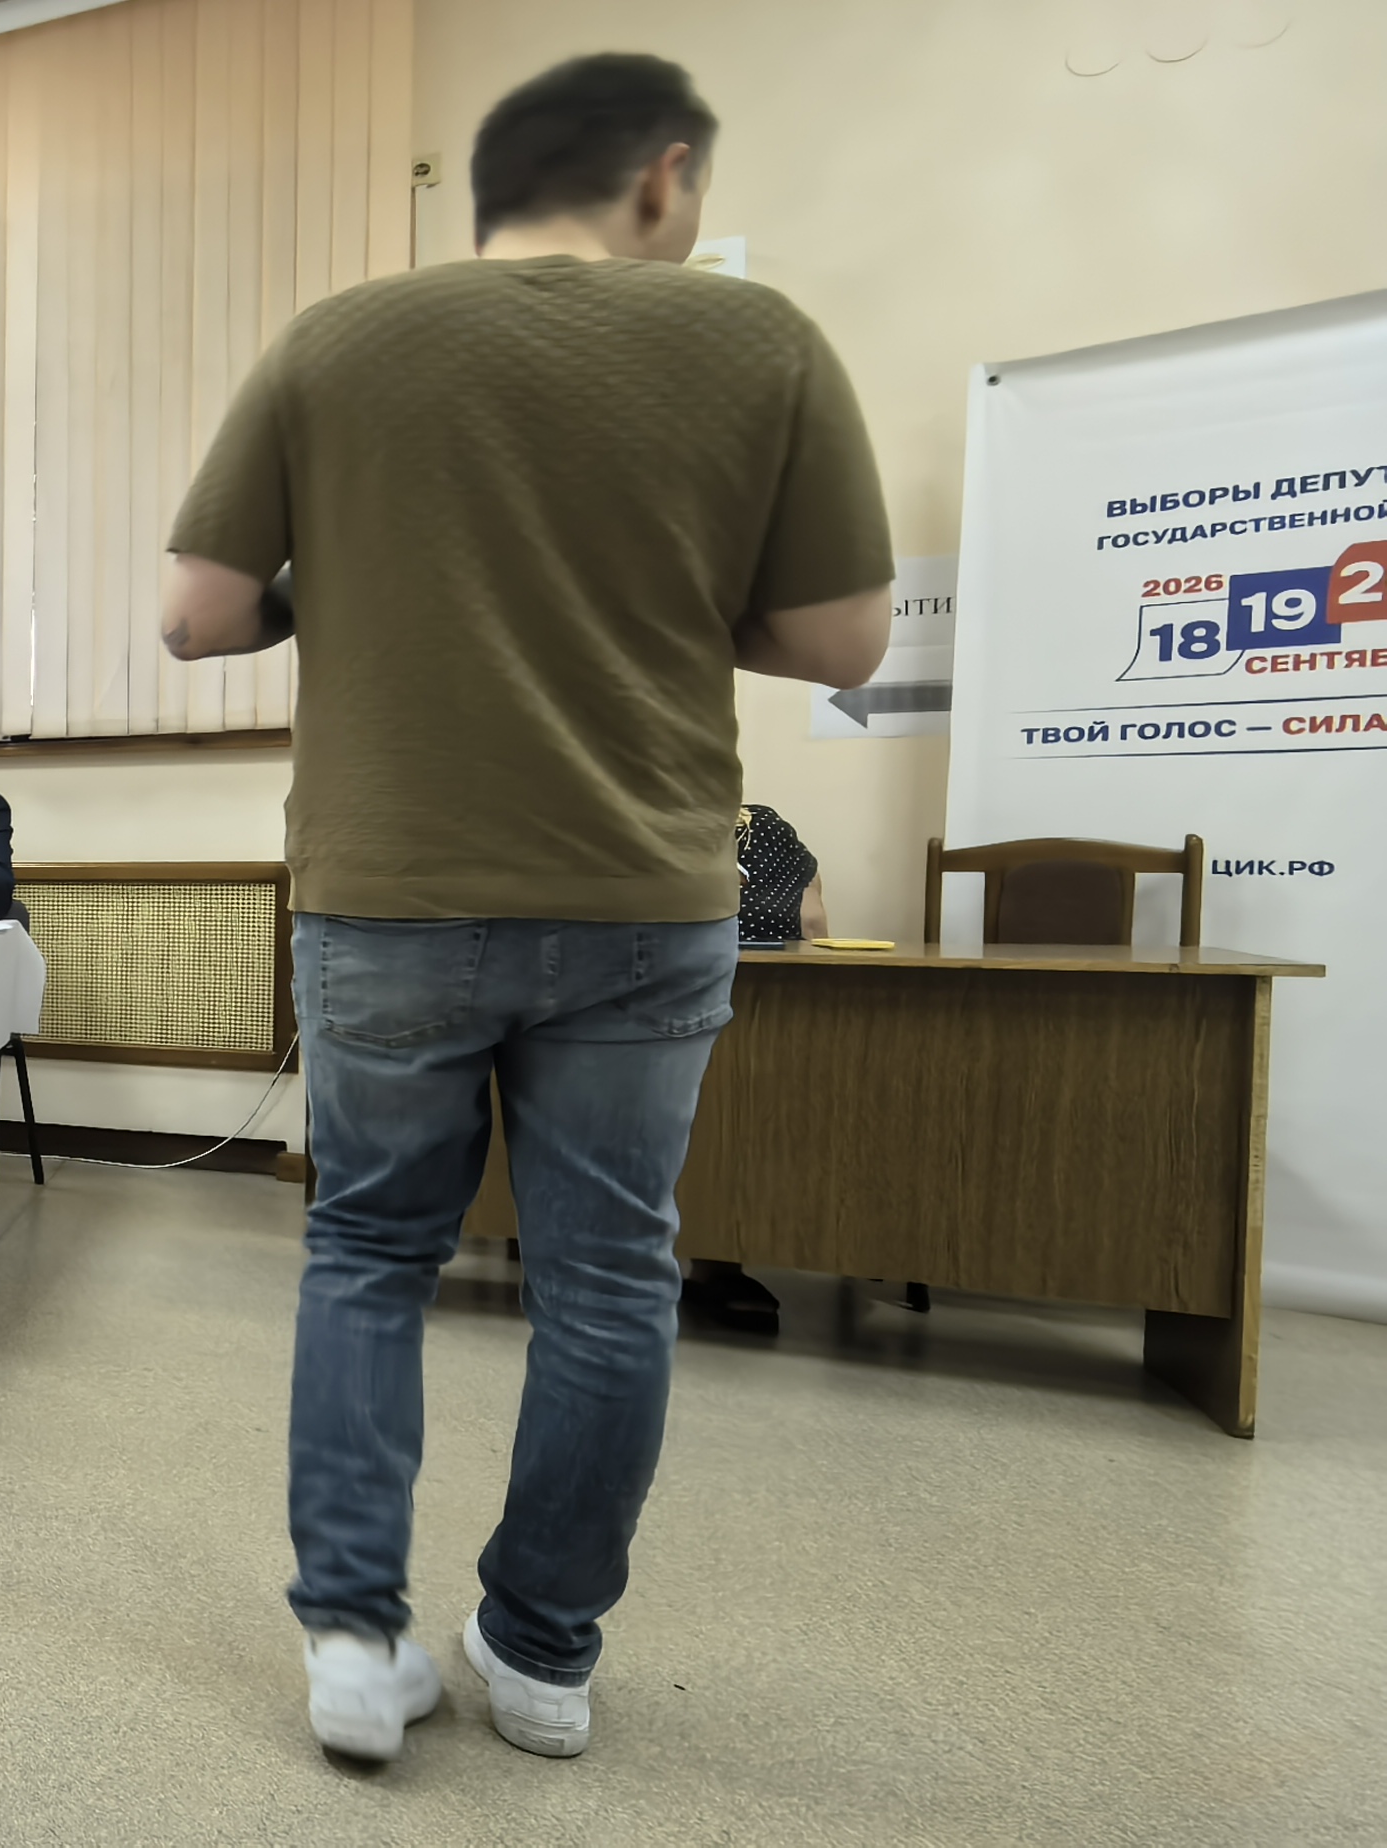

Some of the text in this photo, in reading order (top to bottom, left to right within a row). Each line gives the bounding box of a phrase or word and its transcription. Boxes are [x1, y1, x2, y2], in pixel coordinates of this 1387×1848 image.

[1107, 482, 1261, 518] ВЫБОРЫ
[1141, 574, 1224, 598] 2026
[1149, 620, 1221, 662] 18
[1240, 588, 1317, 633] 19
[1021, 720, 1110, 745] ТВОЙ
[1120, 718, 1237, 740] ГОЛОС
[1281, 713, 1387, 736] СИЛА
[1211, 859, 1336, 878] ЦИК.РФ
